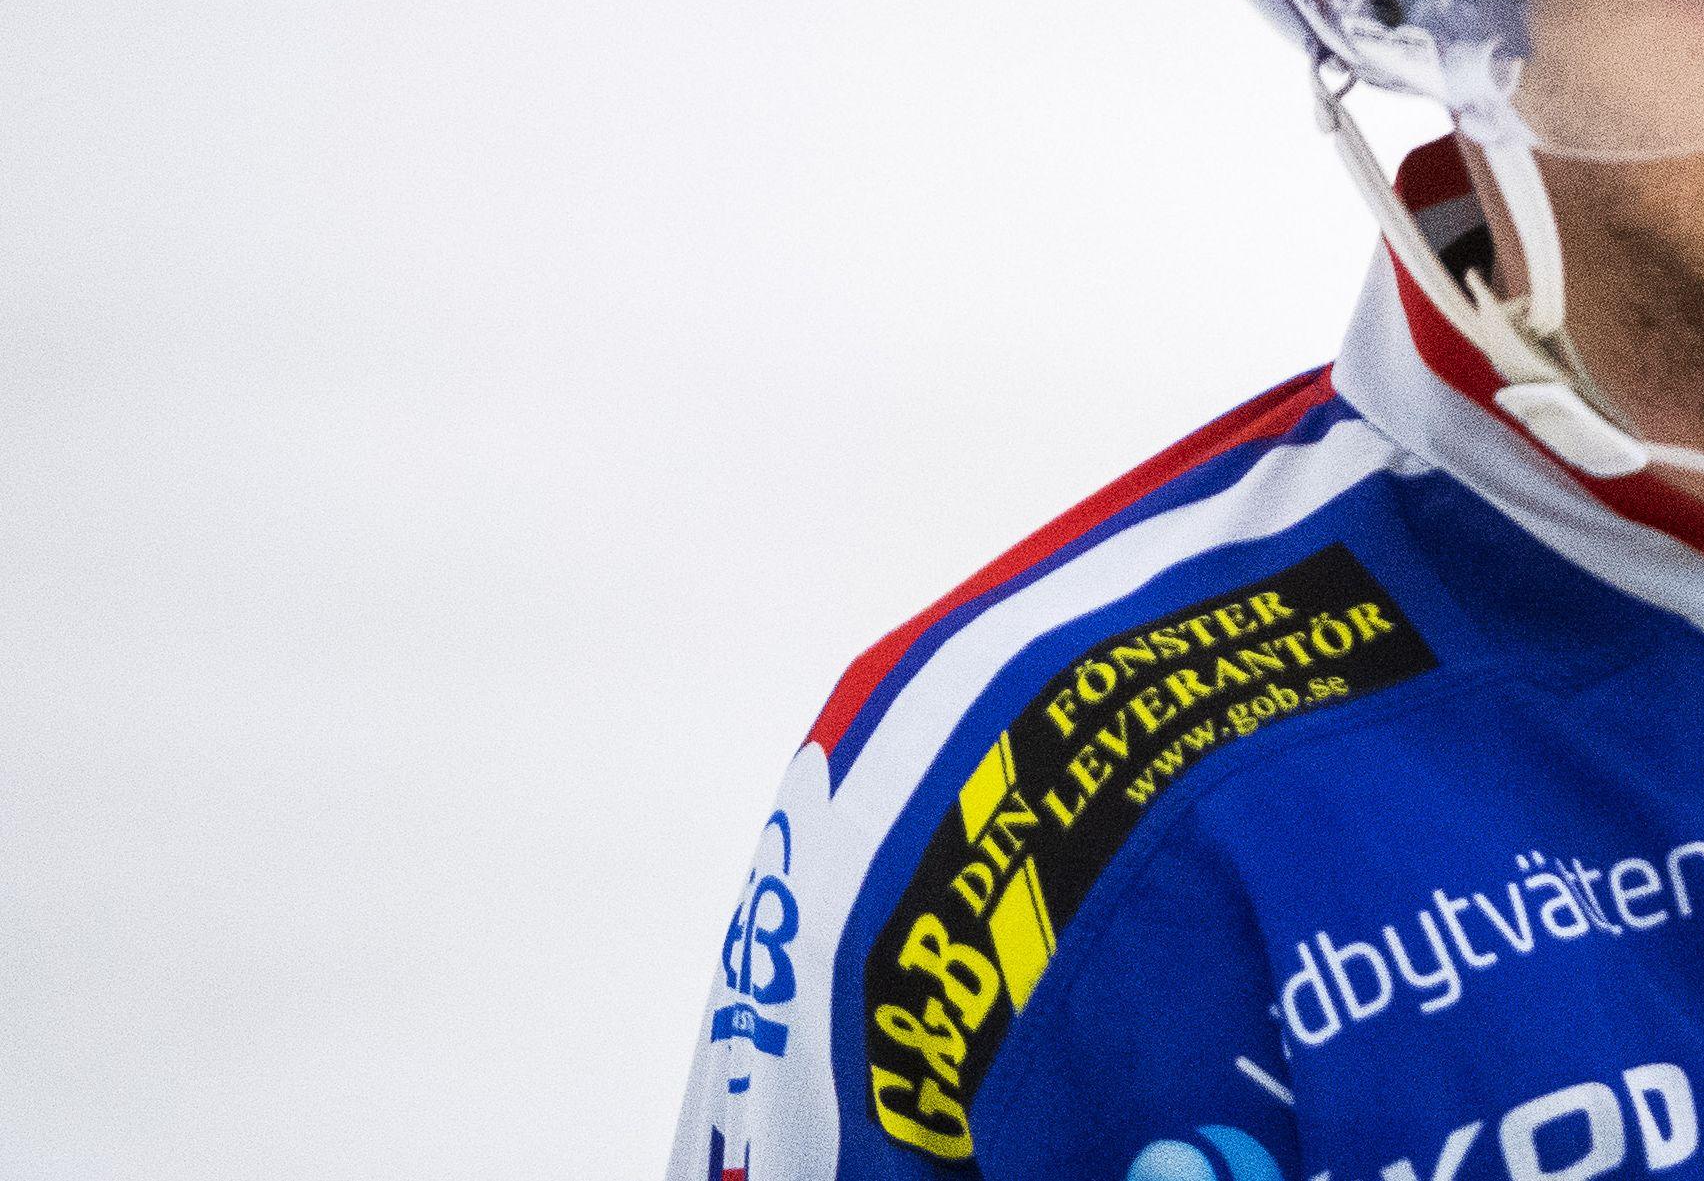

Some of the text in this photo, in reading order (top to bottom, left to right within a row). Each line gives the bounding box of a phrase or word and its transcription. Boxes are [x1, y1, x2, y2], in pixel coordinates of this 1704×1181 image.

[1041, 600, 1394, 829] LEVERANTÖR
[1044, 588, 1297, 739] FÖNSTER
[1123, 670, 1352, 808] www.gob.se
[872, 792, 1041, 1161] G&B DIN
